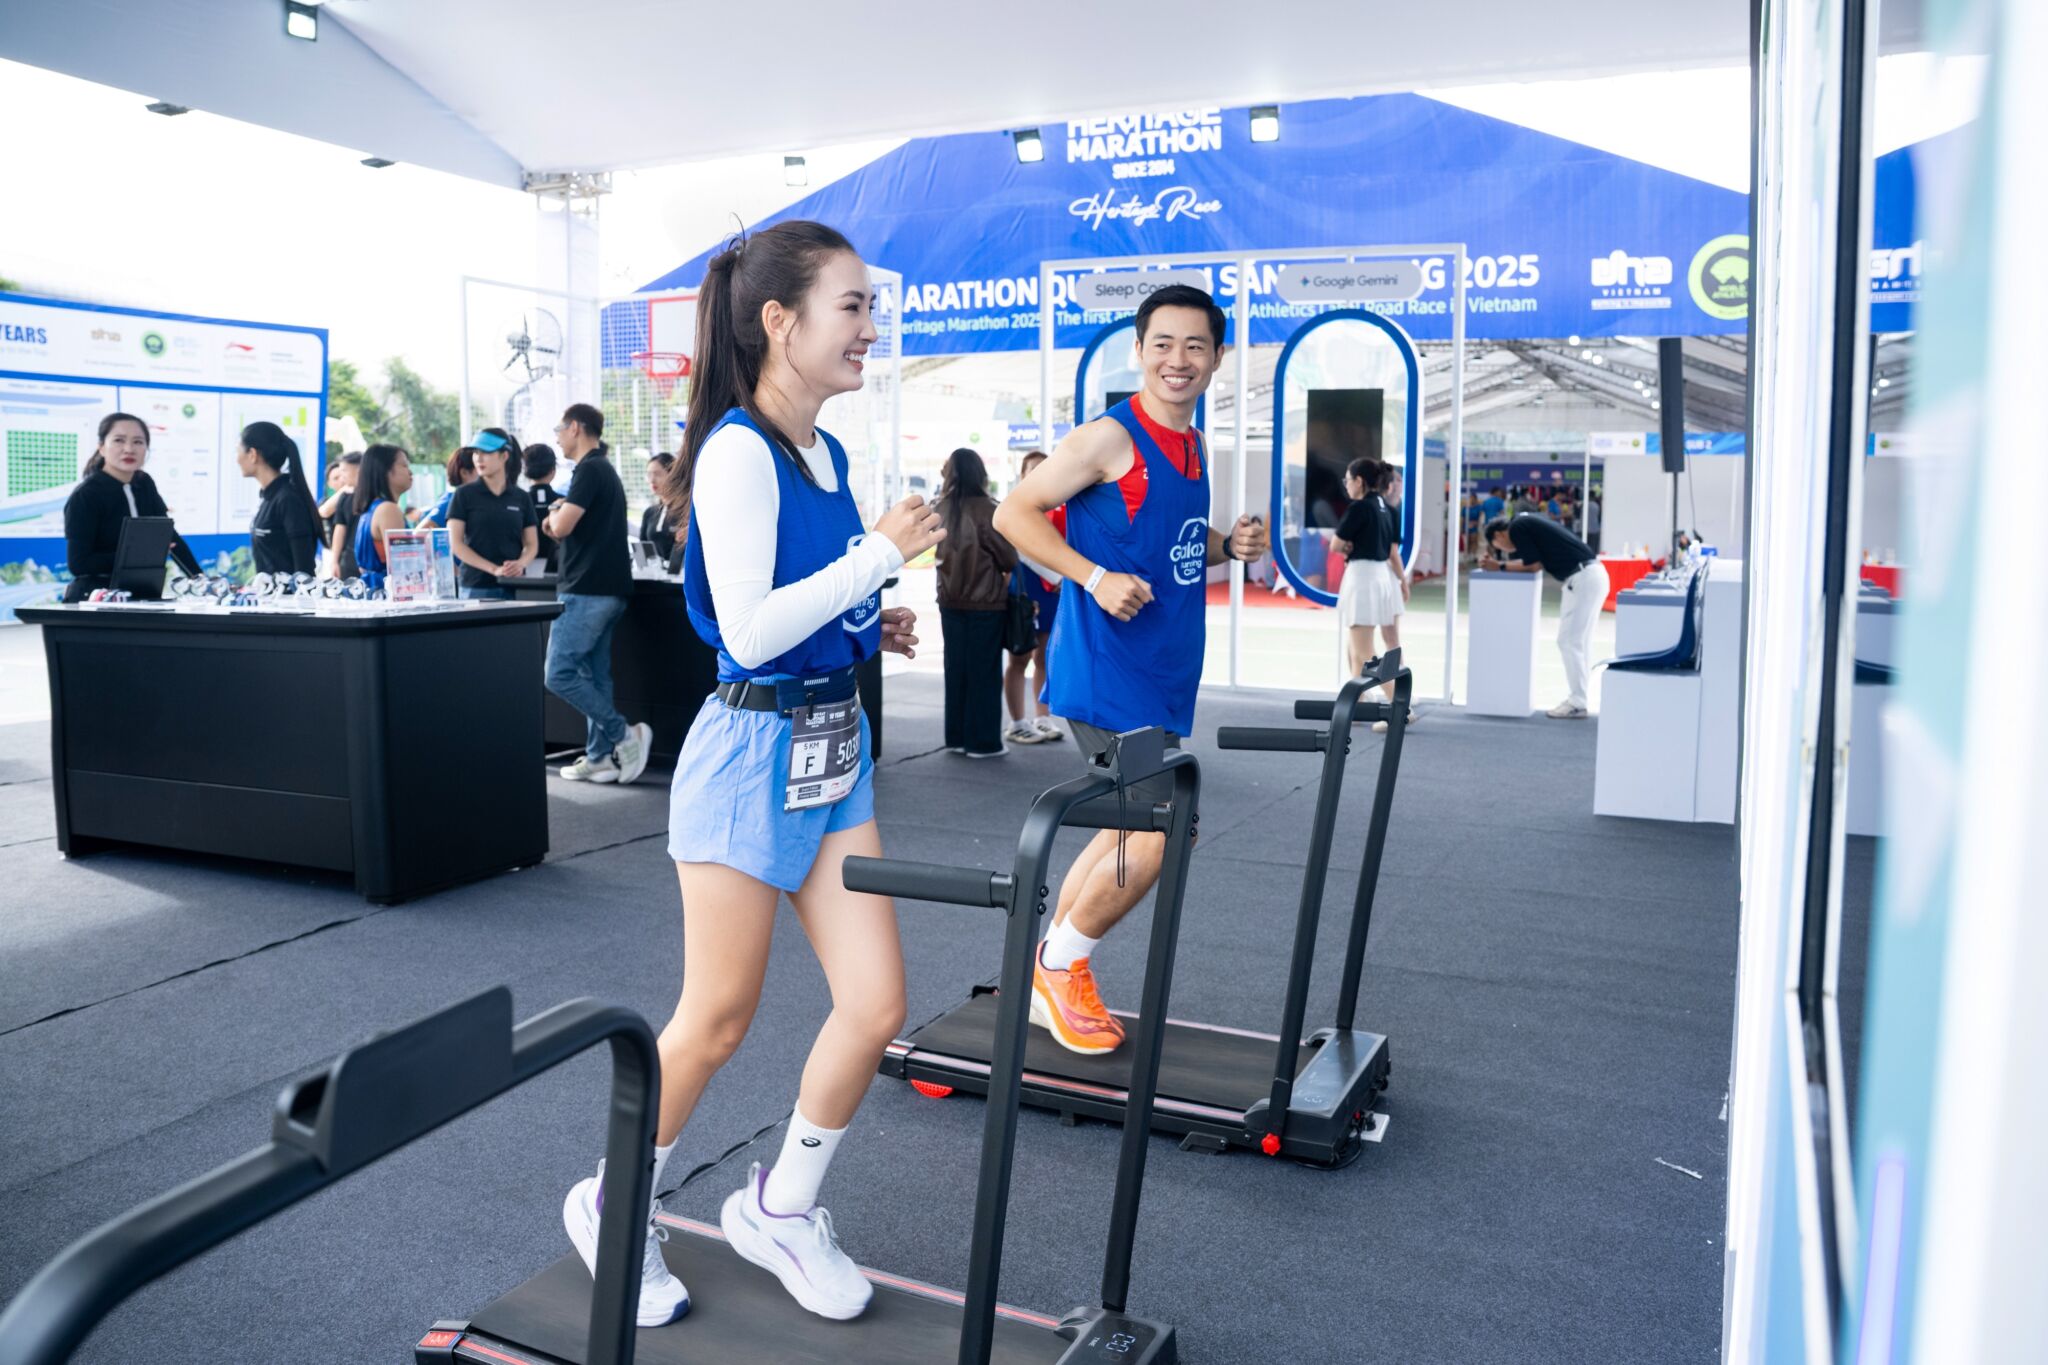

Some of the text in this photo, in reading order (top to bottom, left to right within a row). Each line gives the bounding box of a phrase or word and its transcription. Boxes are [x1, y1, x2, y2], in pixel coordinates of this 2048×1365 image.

[1067, 126, 1222, 163] MARATHON
[1112, 161, 1148, 179] SINCE
[1068, 185, 1222, 231] Heritage Race
[1313, 274, 1398, 290] Google Gemini
[1096, 283, 1135, 300] Sleep
[900, 319, 946, 337] eritage
[947, 314, 1009, 332] Marathon
[1054, 309, 1083, 328] The
[1250, 300, 1317, 319] Athletics
[1407, 299, 1447, 314] Race
[1467, 295, 1538, 313] Vietnam
[805, 756, 815, 774] F
